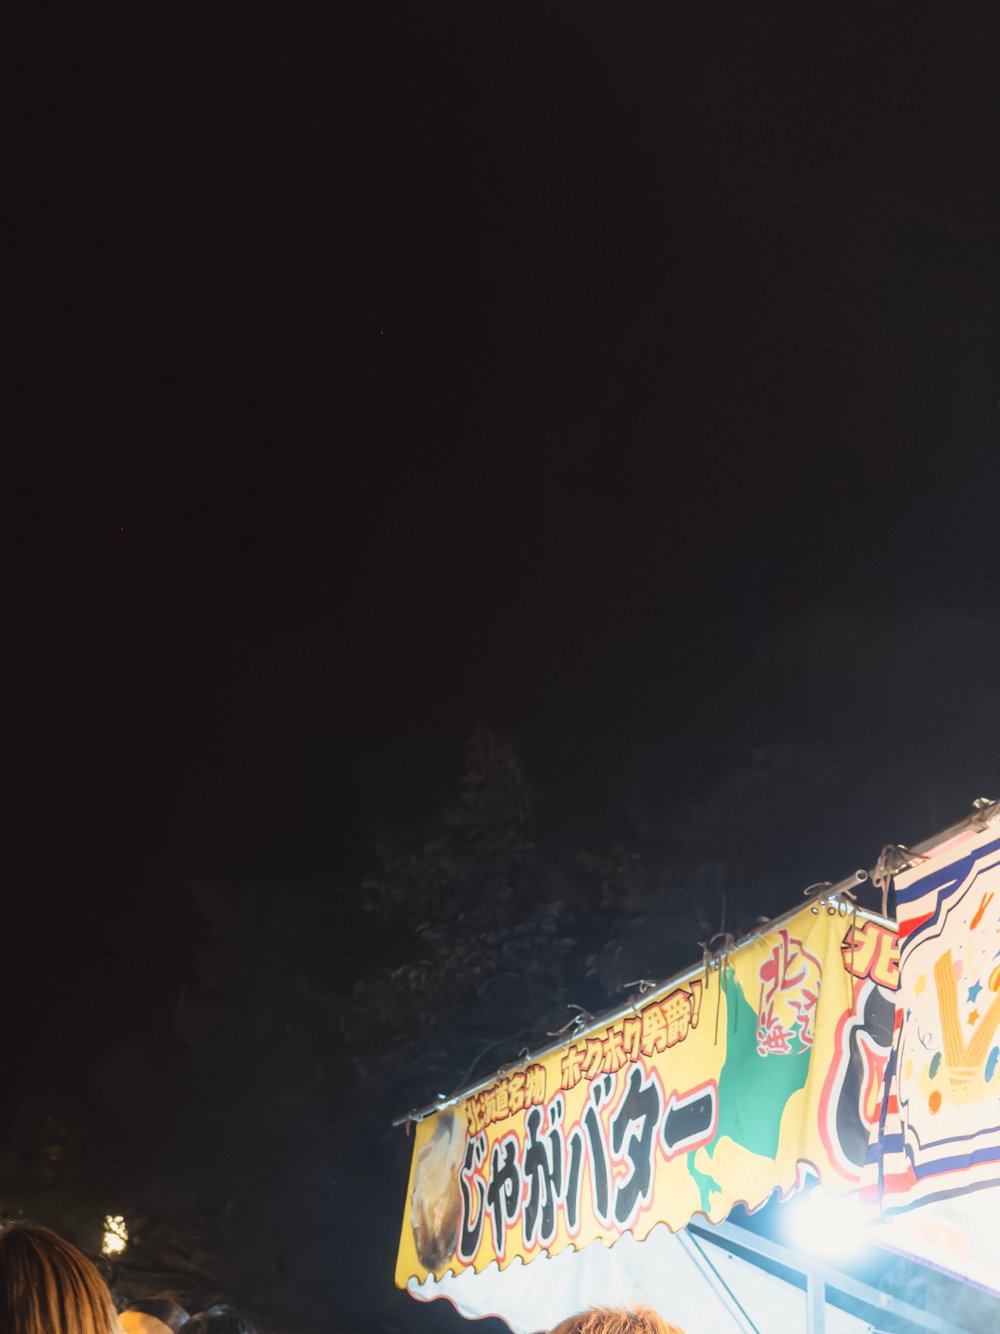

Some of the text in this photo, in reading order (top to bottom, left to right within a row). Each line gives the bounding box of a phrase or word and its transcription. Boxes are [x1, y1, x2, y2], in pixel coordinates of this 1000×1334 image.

[458, 1064, 716, 1263] じゃがバター
[464, 1062, 547, 1137] 北海道名物
